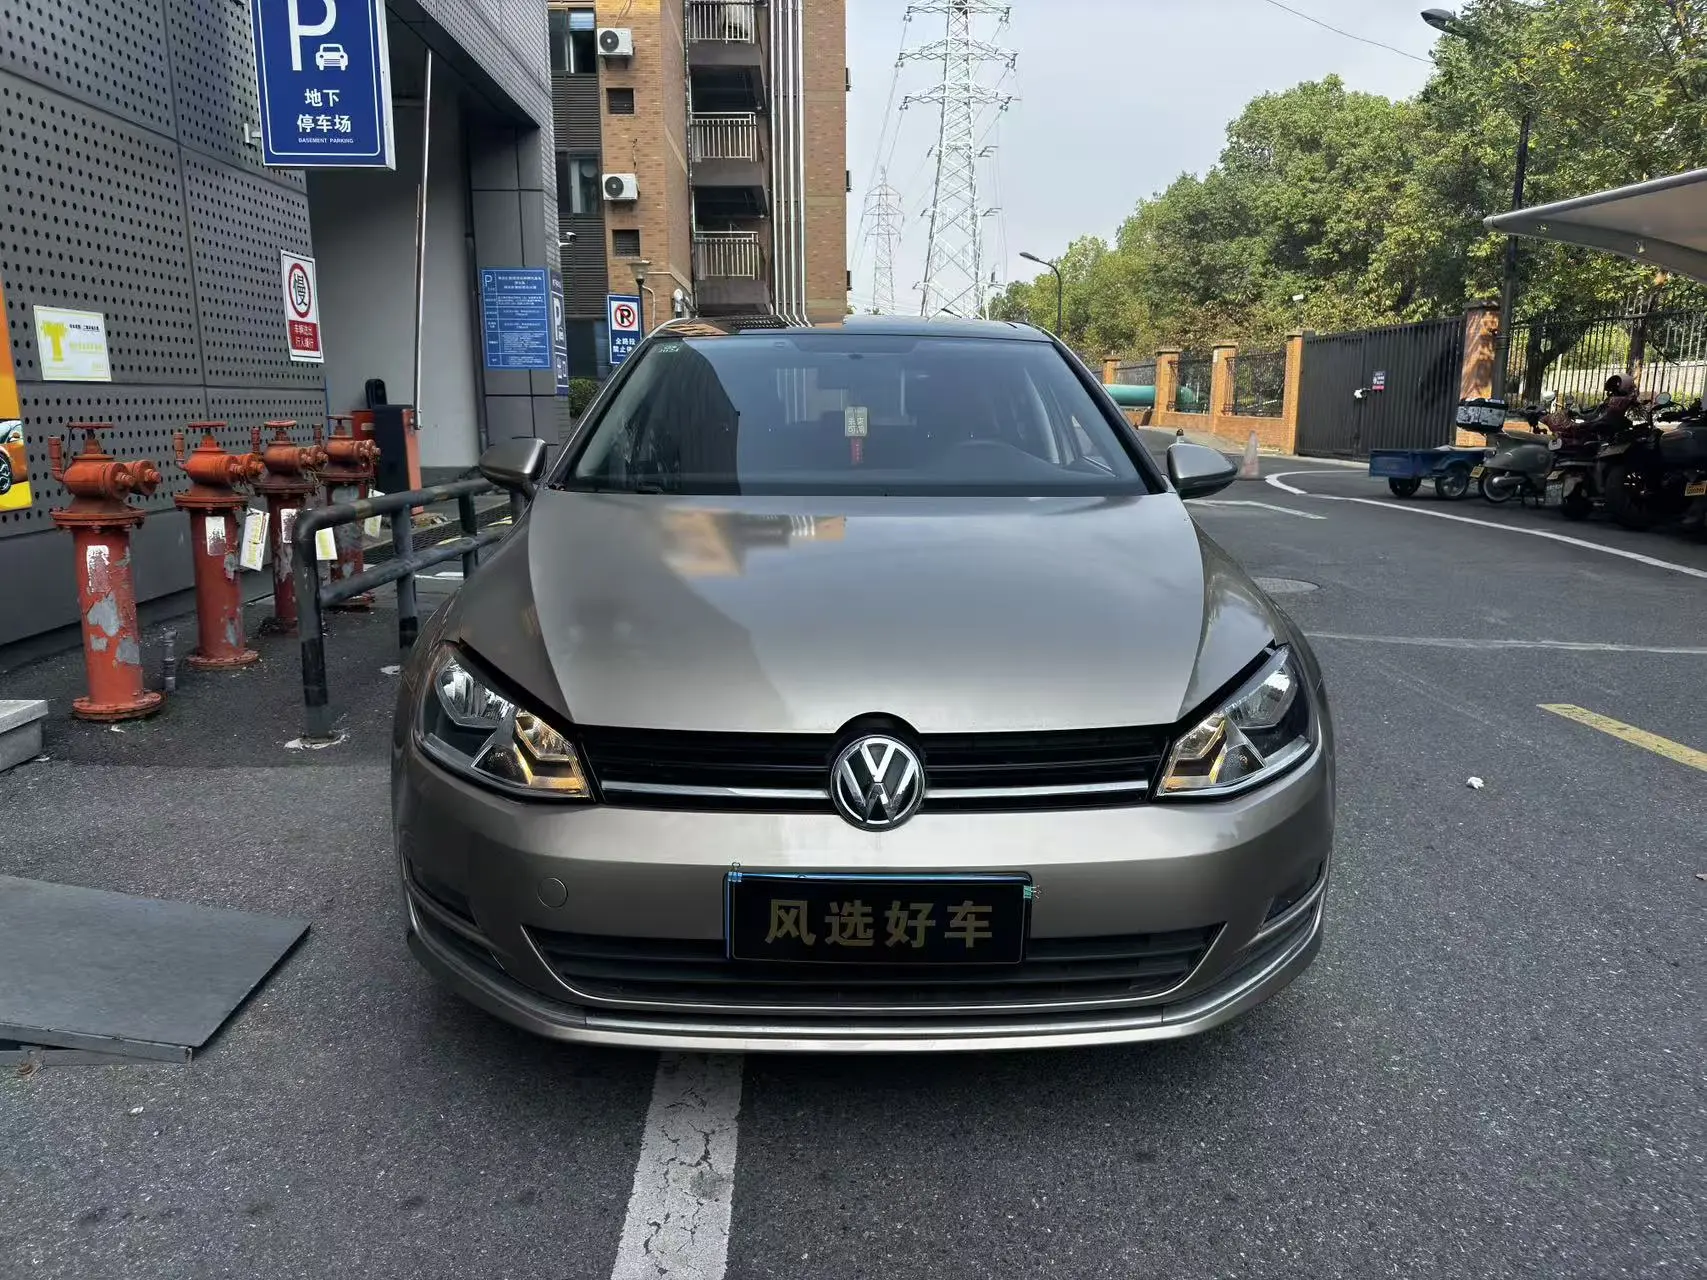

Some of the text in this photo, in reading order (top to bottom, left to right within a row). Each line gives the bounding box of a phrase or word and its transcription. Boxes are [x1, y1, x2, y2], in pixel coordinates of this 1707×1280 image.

[287, 0, 337, 71] P
[304, 88, 340, 107] 地下
[296, 114, 352, 133] 停车场
[293, 272, 308, 307] 慢
[764, 898, 995, 949] 风选好车
